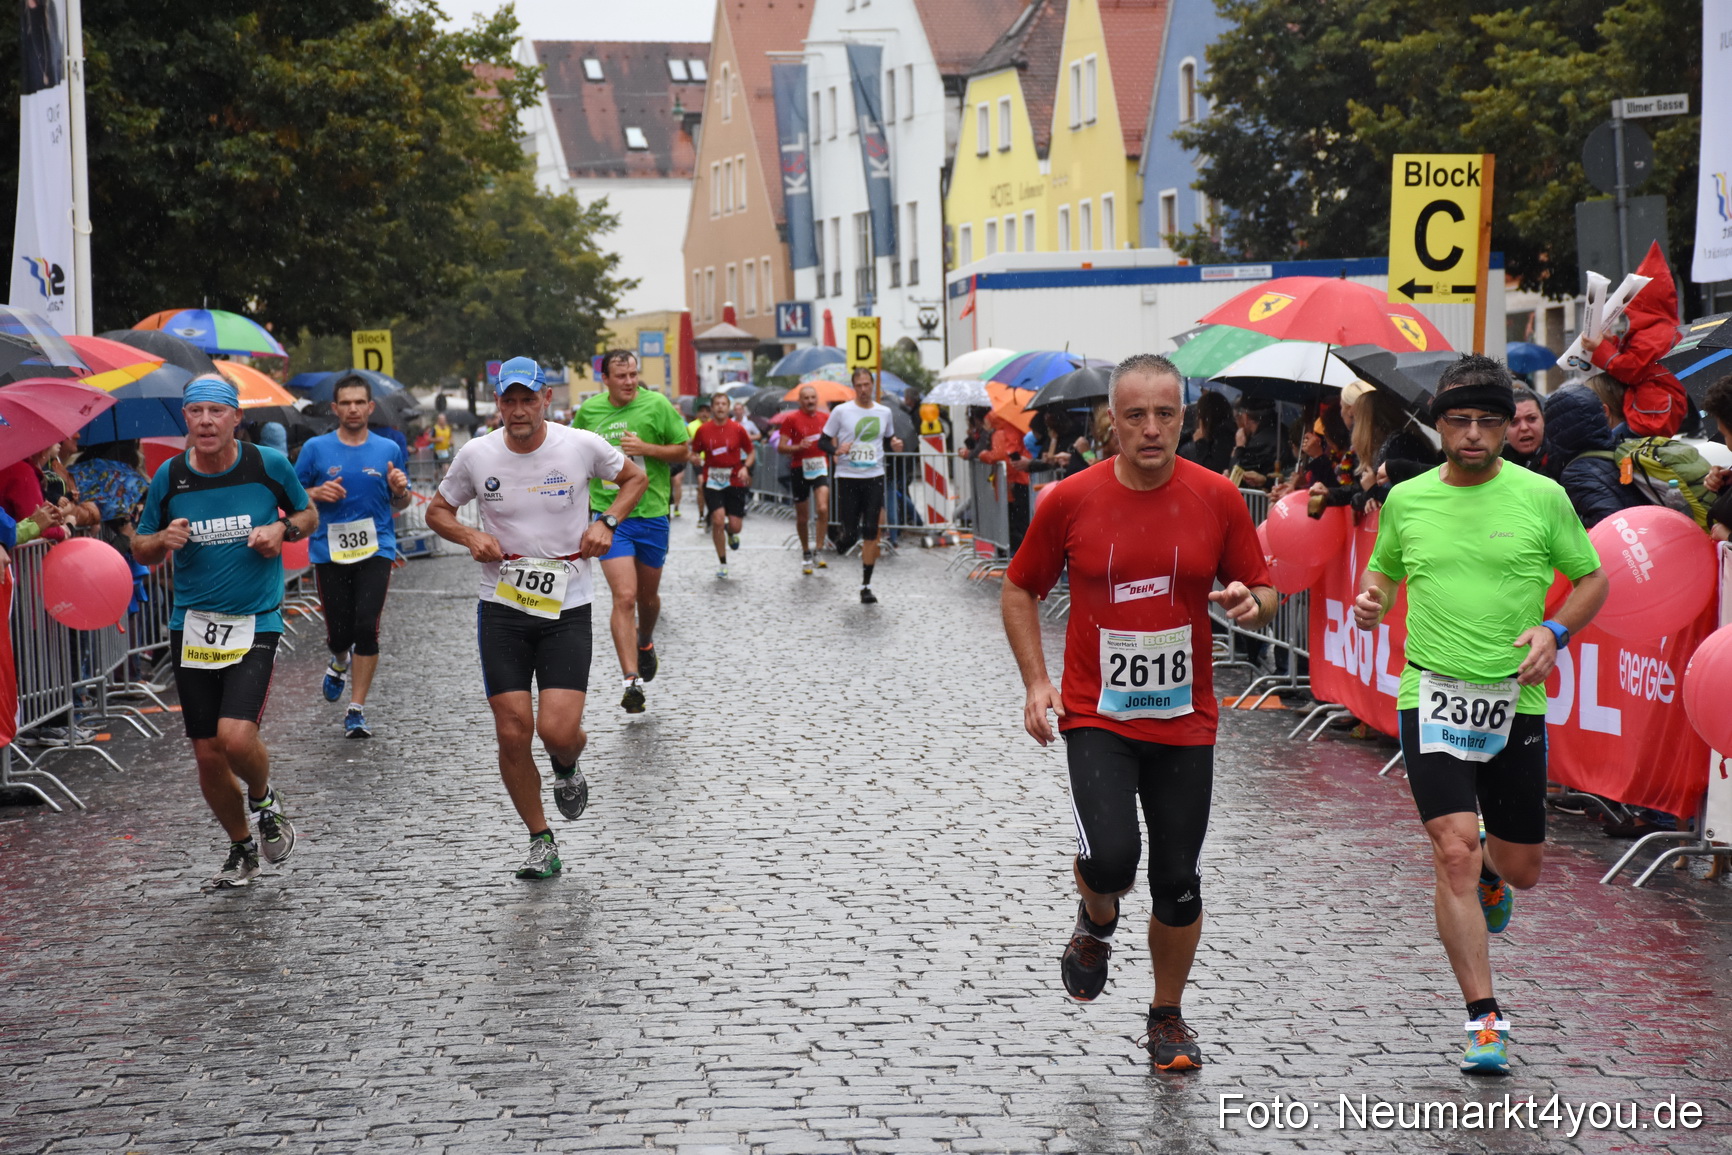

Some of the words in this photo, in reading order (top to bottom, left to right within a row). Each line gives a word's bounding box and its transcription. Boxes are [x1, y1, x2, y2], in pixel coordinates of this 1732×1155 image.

[1657, 100, 1684, 111] Gasse
[1405, 161, 1480, 187] Block
[1414, 199, 1465, 272] C
[851, 319, 876, 330] Block
[357, 333, 387, 344] Block
[856, 335, 872, 361] D
[364, 348, 383, 372] D
[608, 421, 627, 430] JONI
[850, 450, 875, 461] 2715
[189, 515, 252, 536] HUBER
[200, 529, 250, 541] TECHNOLOGY
[338, 530, 369, 549] 338
[515, 568, 556, 595] 758
[1129, 583, 1155, 595] DEHN
[516, 593, 540, 607] Peter
[204, 621, 234, 646] 87
[1107, 640, 1138, 648] NeuerMarkt
[1143, 630, 1186, 647] BOCK
[1109, 650, 1187, 687] 2618
[1125, 695, 1171, 708] Jochen
[1430, 691, 1510, 729] 2306
